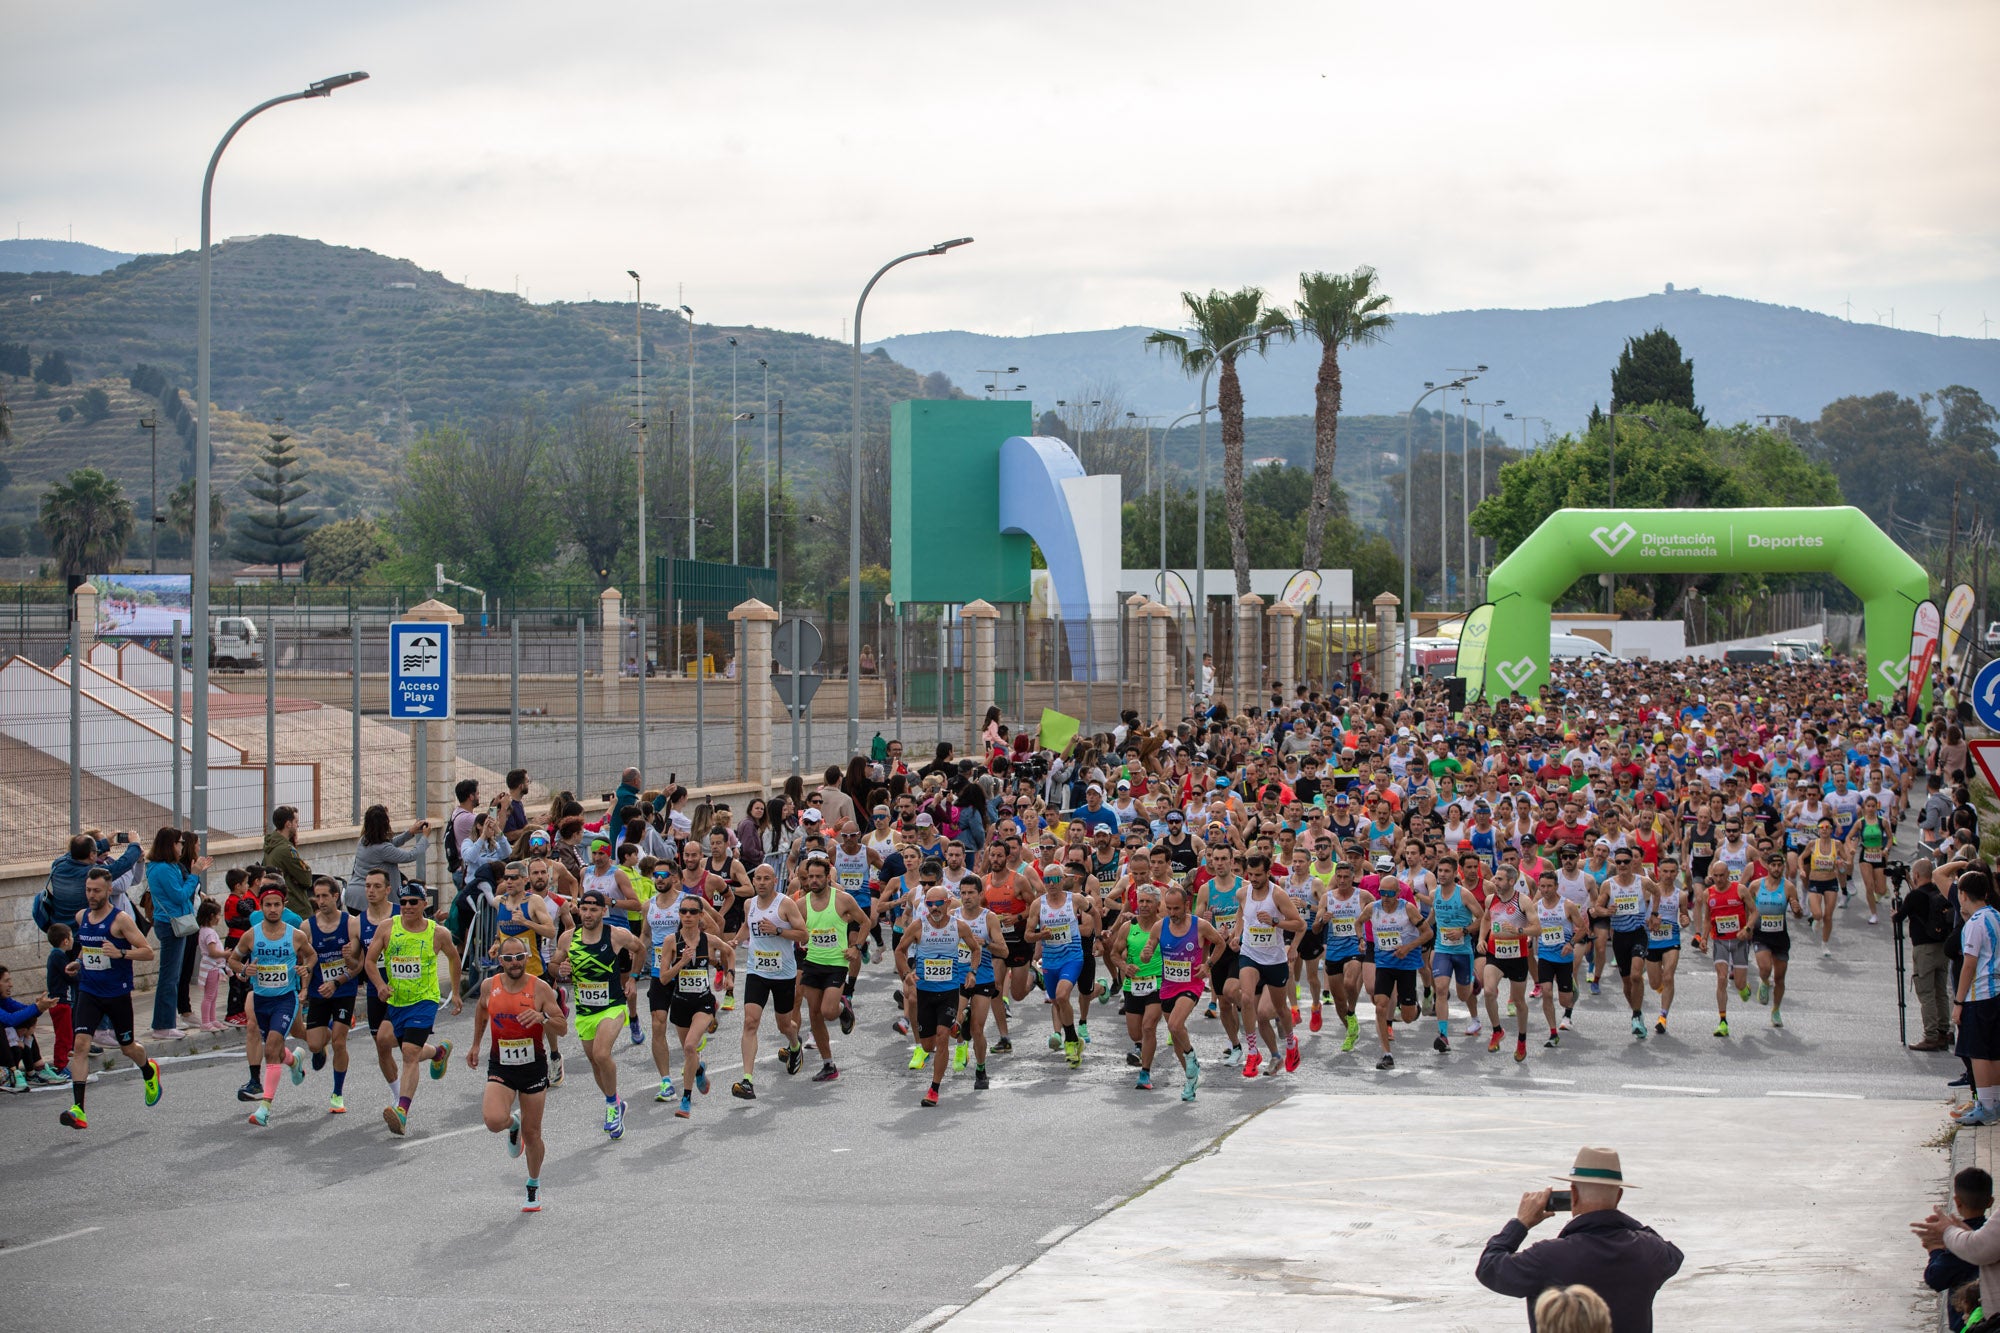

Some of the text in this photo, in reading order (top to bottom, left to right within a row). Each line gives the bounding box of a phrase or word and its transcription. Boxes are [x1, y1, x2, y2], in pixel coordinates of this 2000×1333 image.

[1642, 533, 1716, 547] Diputación
[1748, 534, 1824, 550] Deportes
[1640, 546, 1717, 557] de Granada
[398, 680, 440, 691] Acceso
[403, 691, 435, 704] Playa
[843, 878, 860, 886] 753
[1618, 902, 1636, 911] 985
[1762, 920, 1782, 928] 4031
[812, 933, 837, 944] 3328
[1252, 933, 1273, 943] 757
[1544, 931, 1561, 940] 913
[1380, 938, 1398, 946] 915
[257, 946, 290, 958] nerja
[958, 949, 971, 959] 57
[1496, 945, 1519, 955] 4017
[87, 954, 102, 965] 34
[757, 957, 778, 967] 283
[392, 963, 420, 974] 1003
[925, 966, 952, 976] 3282
[1164, 966, 1190, 977] 3295
[258, 972, 287, 982] 3220
[680, 977, 708, 988] 3351
[1135, 982, 1153, 991] 274
[579, 989, 608, 1000] 1054
[504, 1046, 528, 1059] 111
